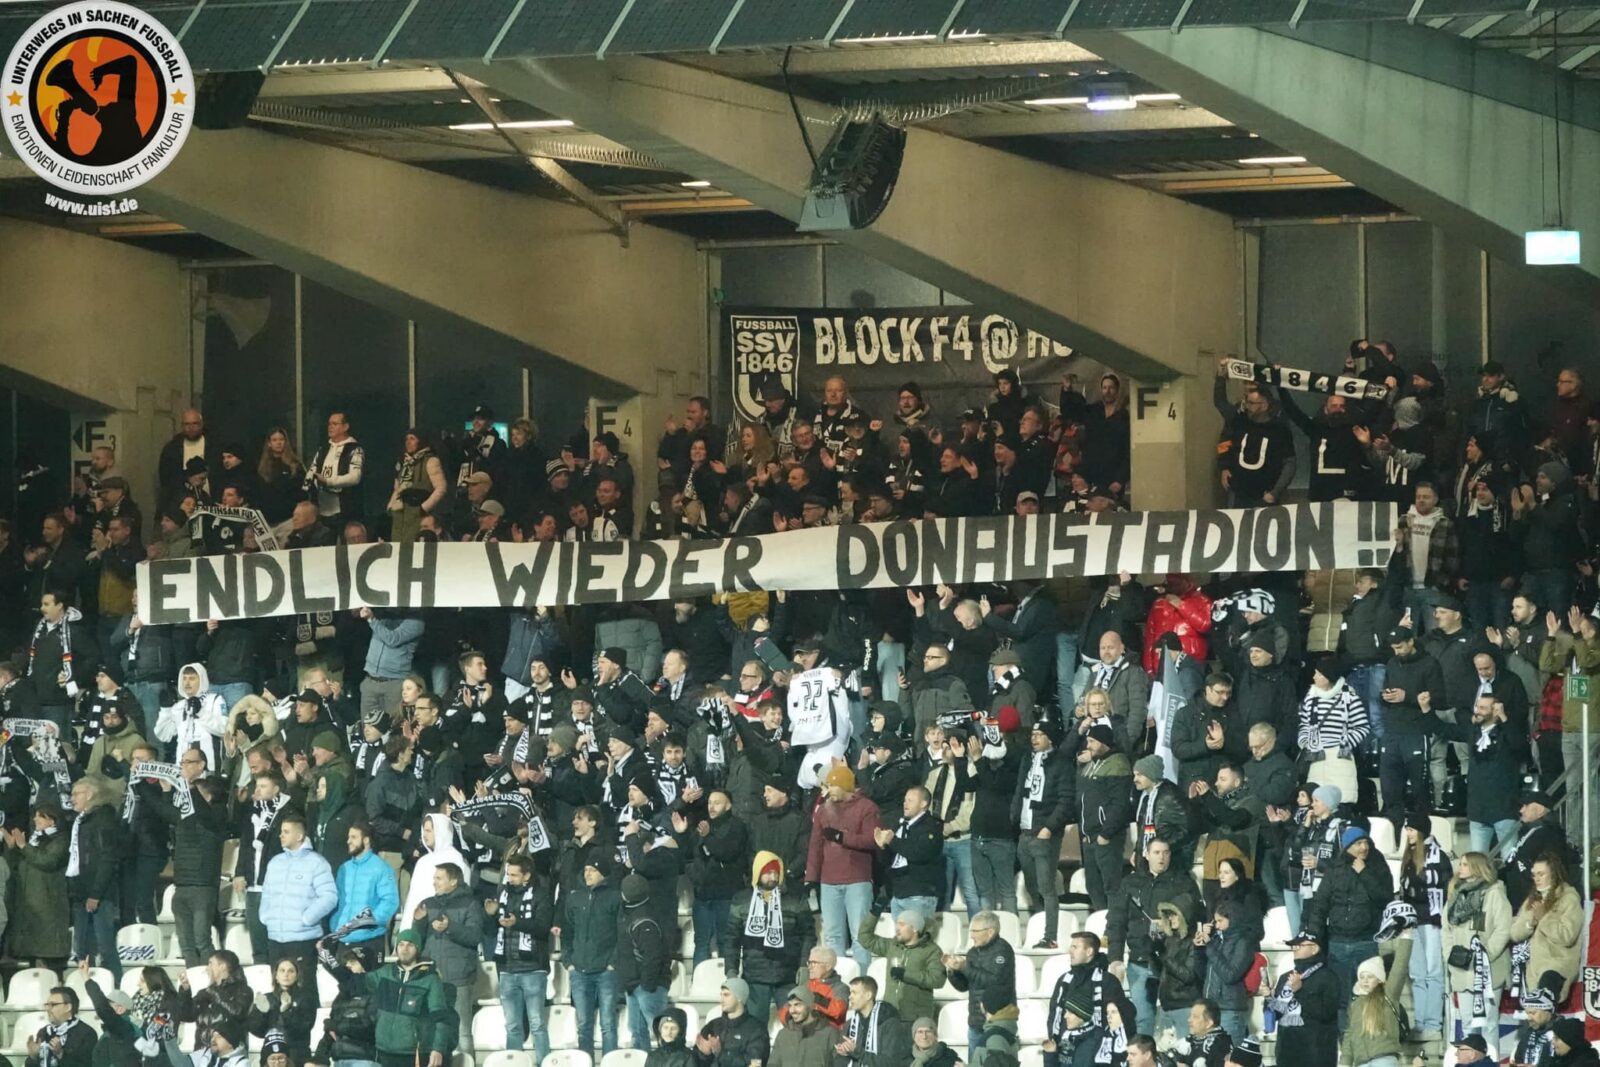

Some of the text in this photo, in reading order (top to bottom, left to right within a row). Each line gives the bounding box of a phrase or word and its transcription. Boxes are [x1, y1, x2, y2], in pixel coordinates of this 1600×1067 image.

[735, 320, 796, 330] FUSSBALL
[736, 331, 796, 353] SSV
[813, 316, 925, 365] BLOCK
[929, 315, 973, 362] F4
[736, 352, 794, 373] 1846
[150, 501, 1391, 624] ENDLICH WIEDER DONAUSTADION !!
[1584, 979, 1600, 992] 18
